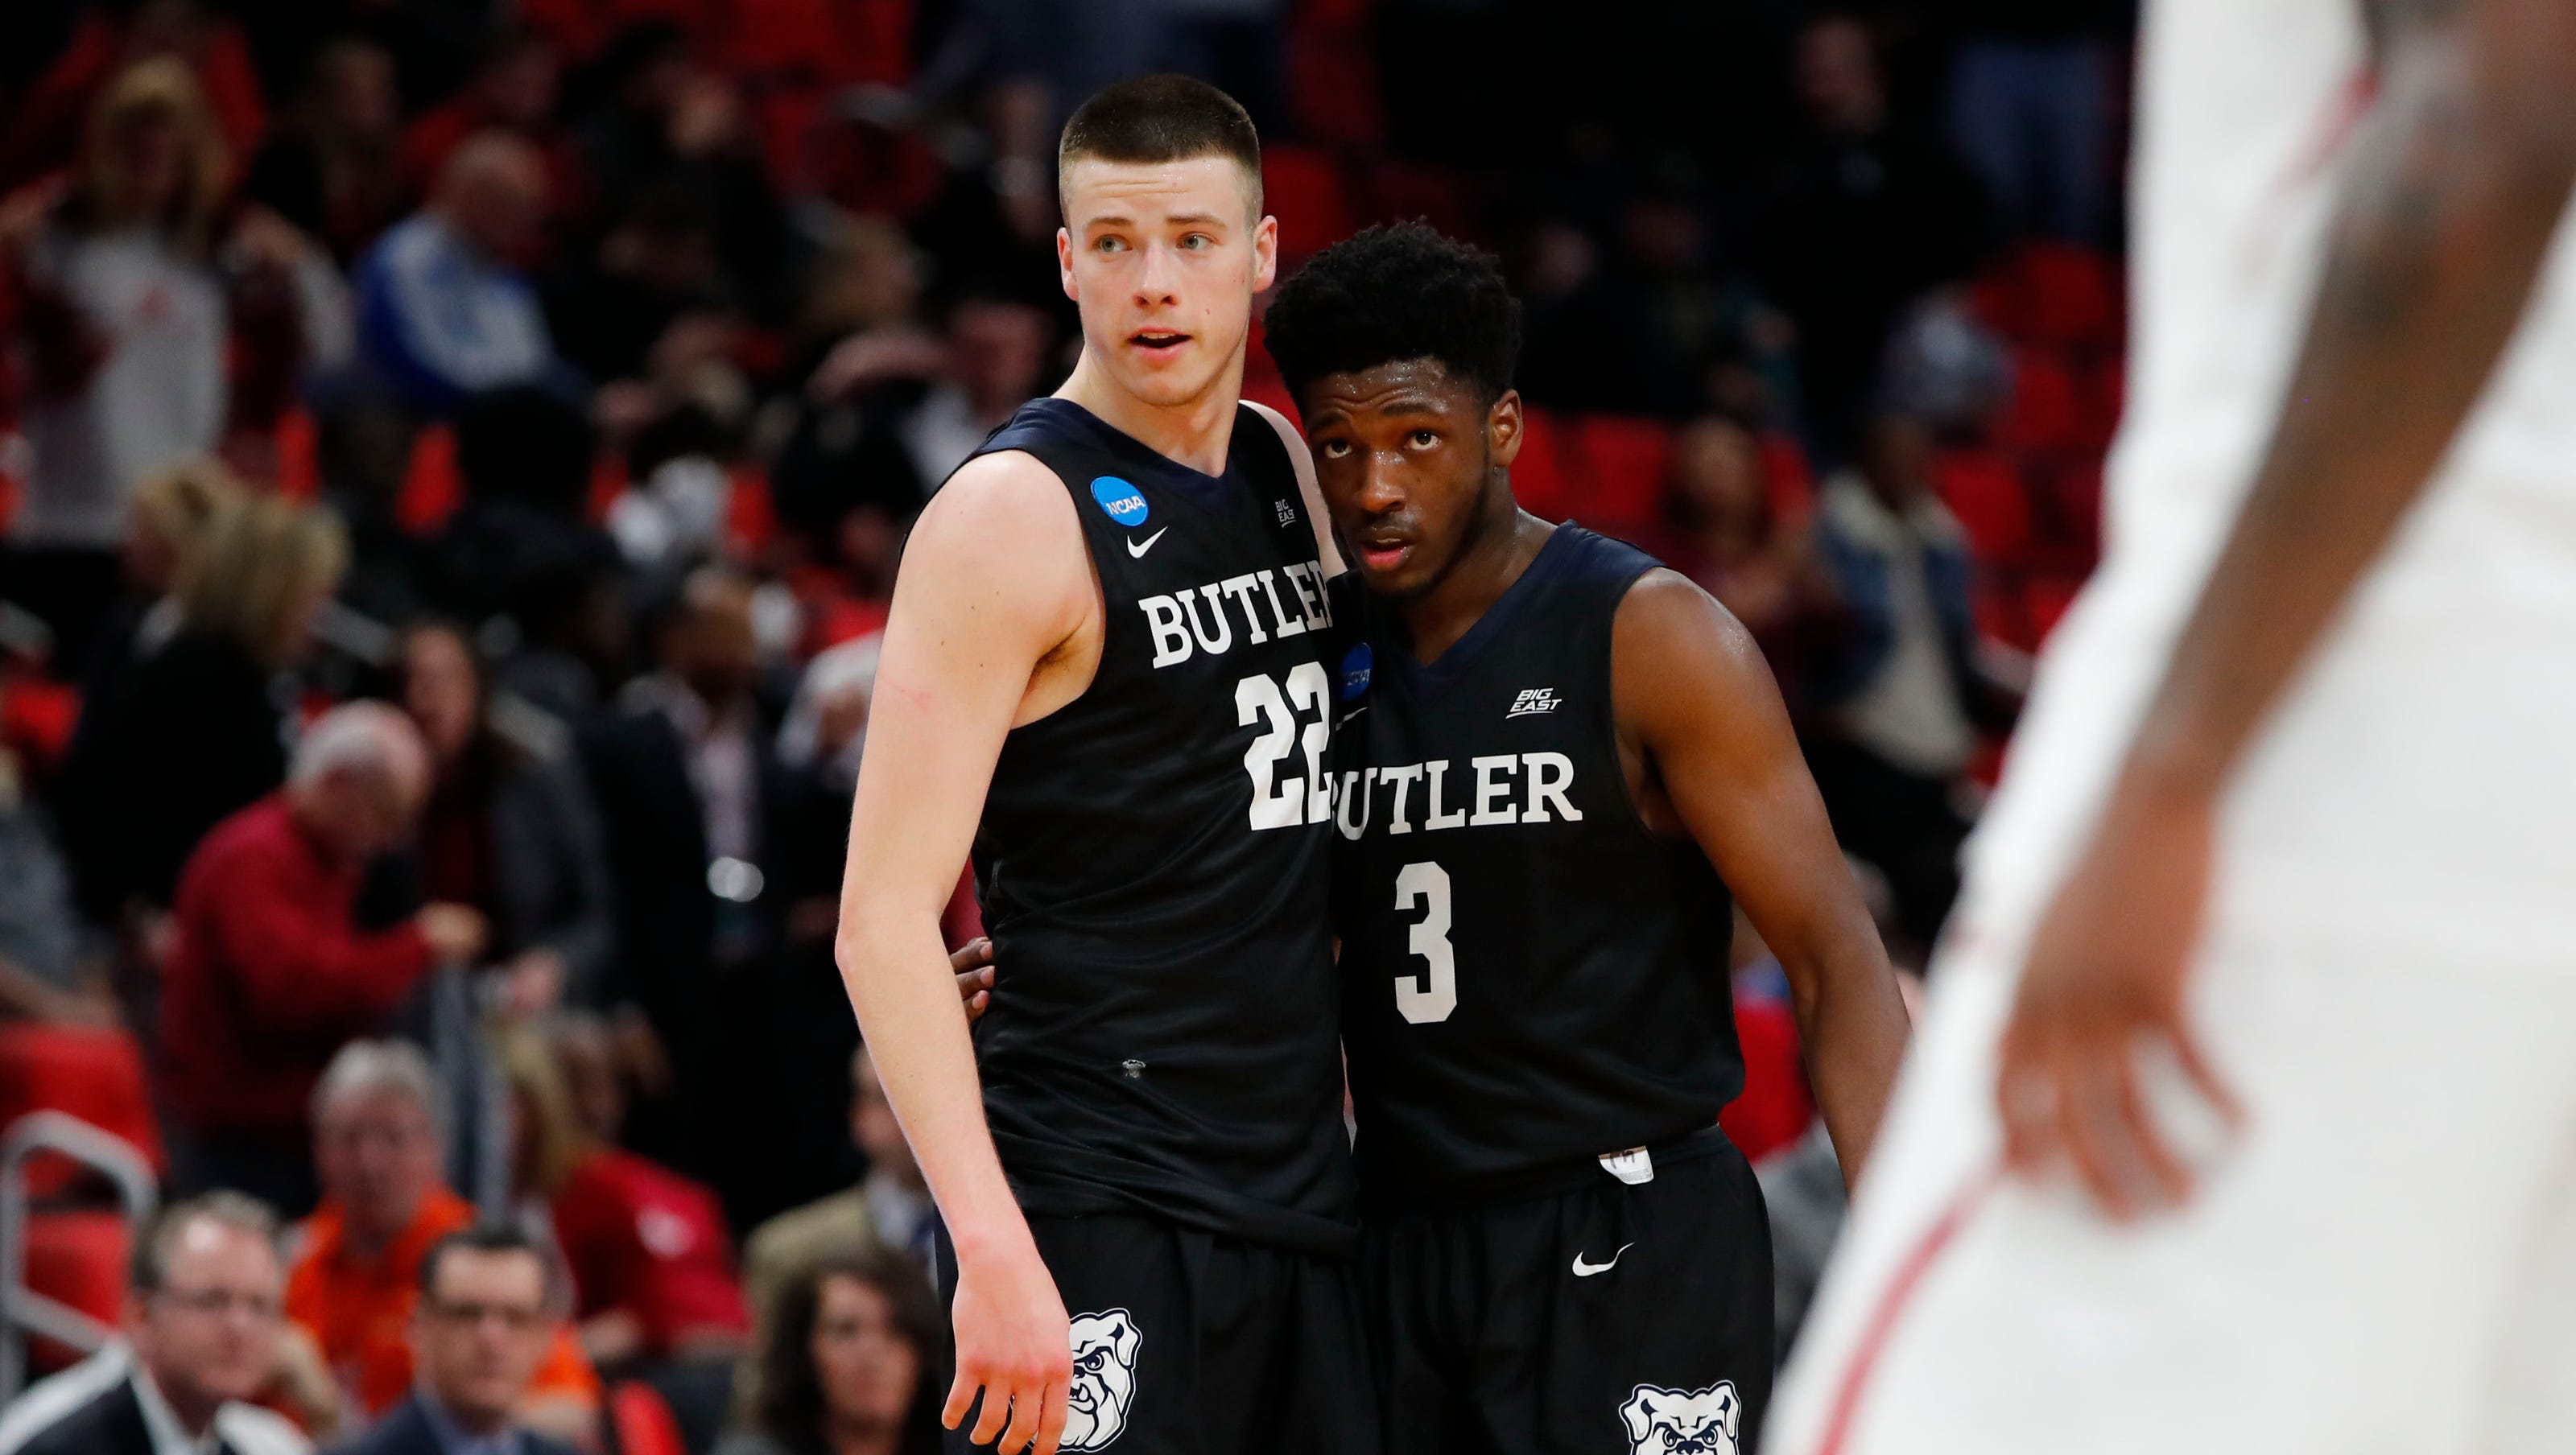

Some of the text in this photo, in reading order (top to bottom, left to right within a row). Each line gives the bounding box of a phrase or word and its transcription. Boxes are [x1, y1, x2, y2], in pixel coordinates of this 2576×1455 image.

[1105, 495, 1146, 515] NCAA
[1274, 498, 1290, 512] BIG
[1516, 687, 1554, 701] BIG
[1509, 699, 1563, 713] EAST
[1234, 661, 1331, 831] 22
[1331, 751, 1583, 841] UTLER
[1394, 860, 1458, 1024] 3
